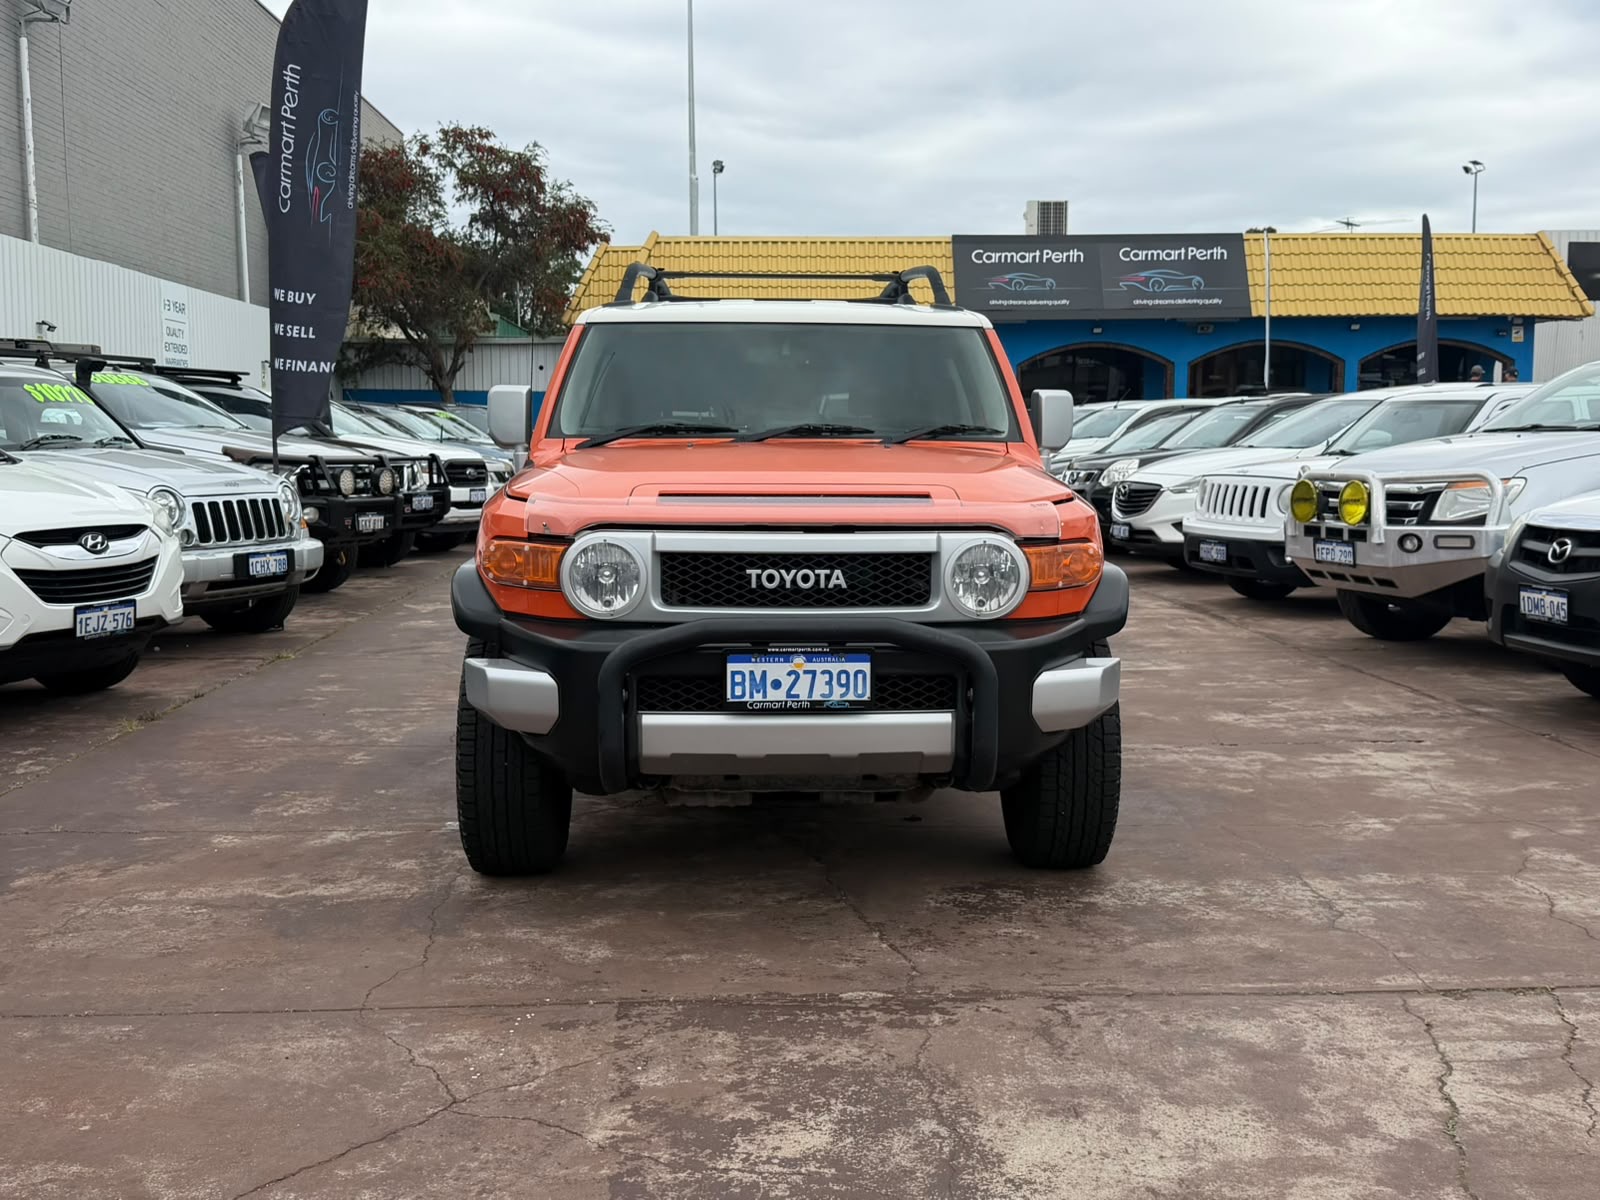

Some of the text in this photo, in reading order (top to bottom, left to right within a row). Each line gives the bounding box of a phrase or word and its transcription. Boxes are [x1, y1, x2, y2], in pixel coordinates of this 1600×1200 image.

[279, 63, 301, 213] Carmart Perth
[350, 117, 359, 154] delivering
[347, 154, 357, 183] dreams
[347, 183, 356, 209] driving
[971, 248, 1084, 264] Carmart Perth
[1119, 246, 1228, 261] Carmart Perth
[287, 290, 316, 305] BUY
[171, 300, 186, 315] YEAR
[286, 325, 316, 339] SELL
[745, 568, 847, 589] TOYOTA
[747, 700, 811, 710] Carmart Perth
